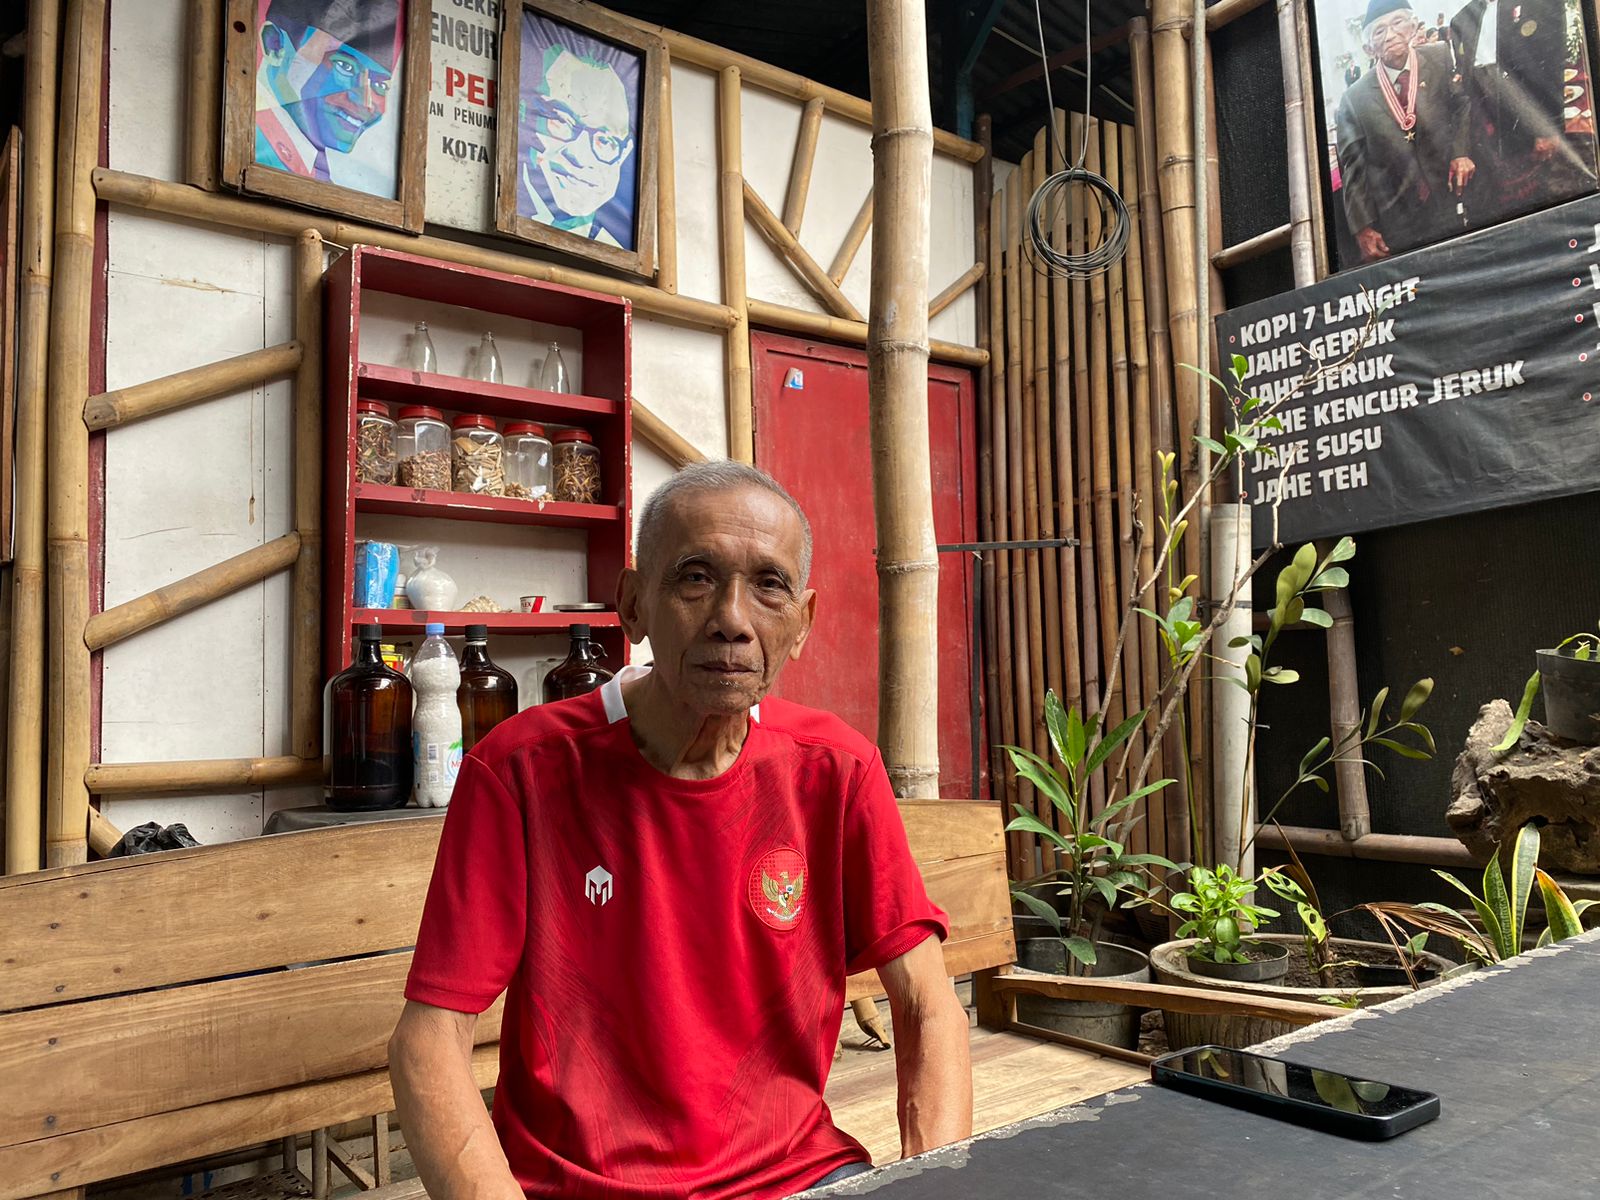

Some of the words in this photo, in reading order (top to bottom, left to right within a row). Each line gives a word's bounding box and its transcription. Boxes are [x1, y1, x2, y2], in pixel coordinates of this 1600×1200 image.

[429, 101, 444, 117] AN
[442, 136, 489, 164] KOTA
[1240, 312, 1297, 347] KOPI
[1303, 305, 1316, 330] 7
[1323, 277, 1420, 325] LANGIT
[1245, 342, 1302, 380] JAHE
[1312, 354, 1396, 396] JERUK
[1314, 383, 1420, 428] KENCUR
[1428, 360, 1526, 405] JERUK
[1251, 439, 1309, 474] JAHE
[1316, 425, 1383, 461] SUSU
[1253, 471, 1312, 506] JAHE
[1318, 461, 1369, 492] TEH
